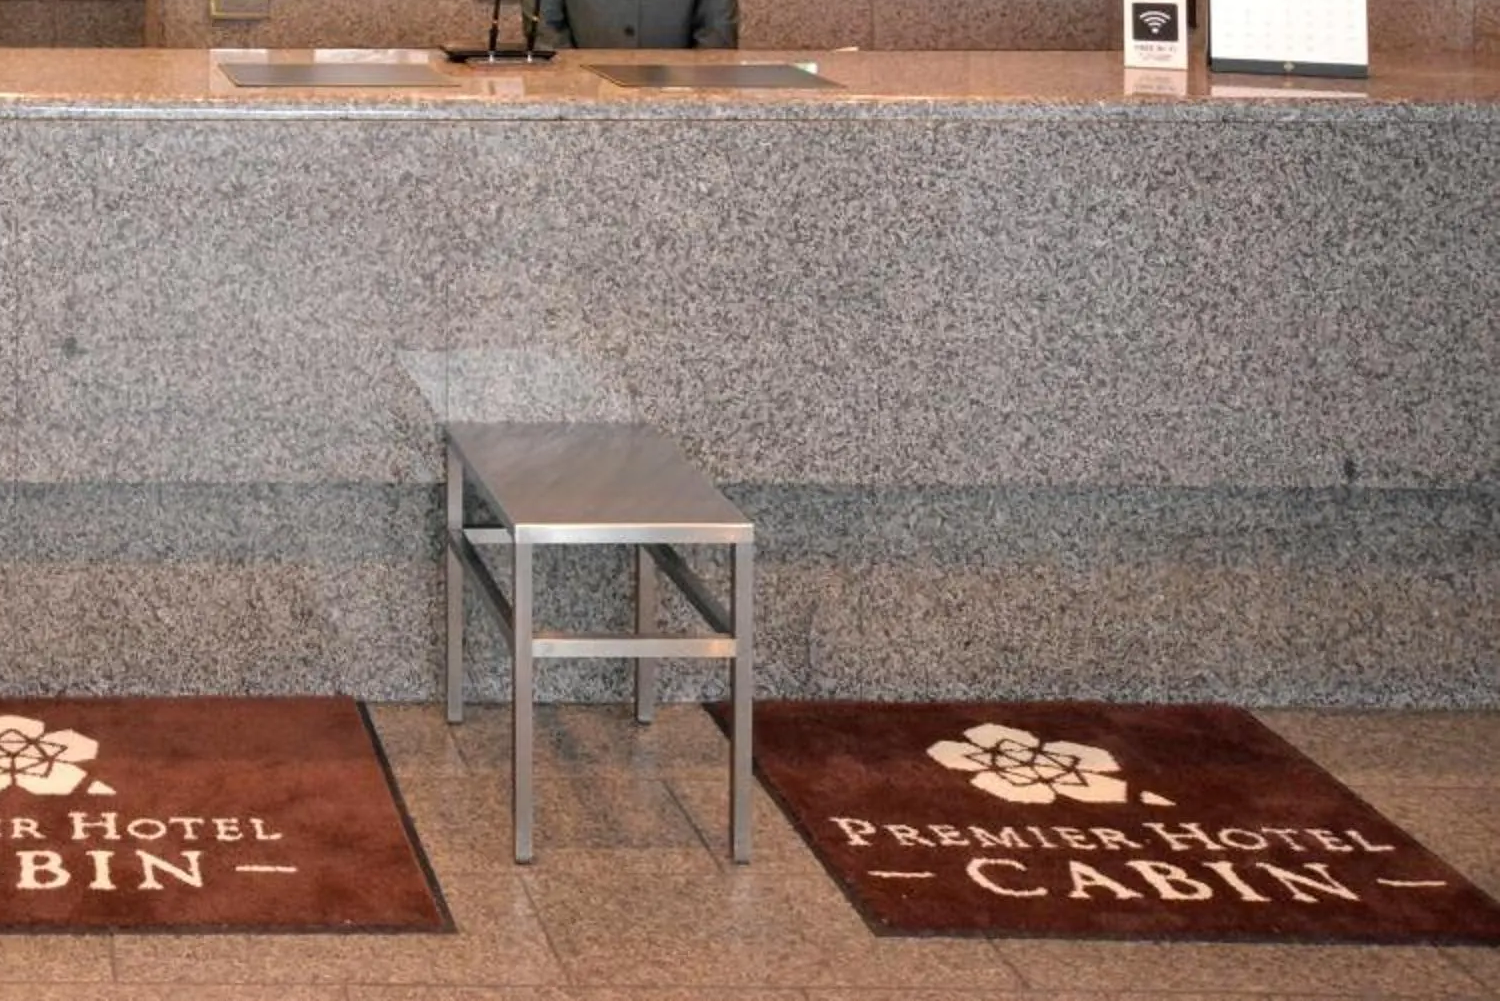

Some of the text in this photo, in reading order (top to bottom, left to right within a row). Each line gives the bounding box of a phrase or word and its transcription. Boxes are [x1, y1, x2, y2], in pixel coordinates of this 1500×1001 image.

[68, 811, 283, 842] HOTEL
[830, 817, 1395, 852] PREMIER HOTEL
[967, 857, 1358, 903] CABIN
